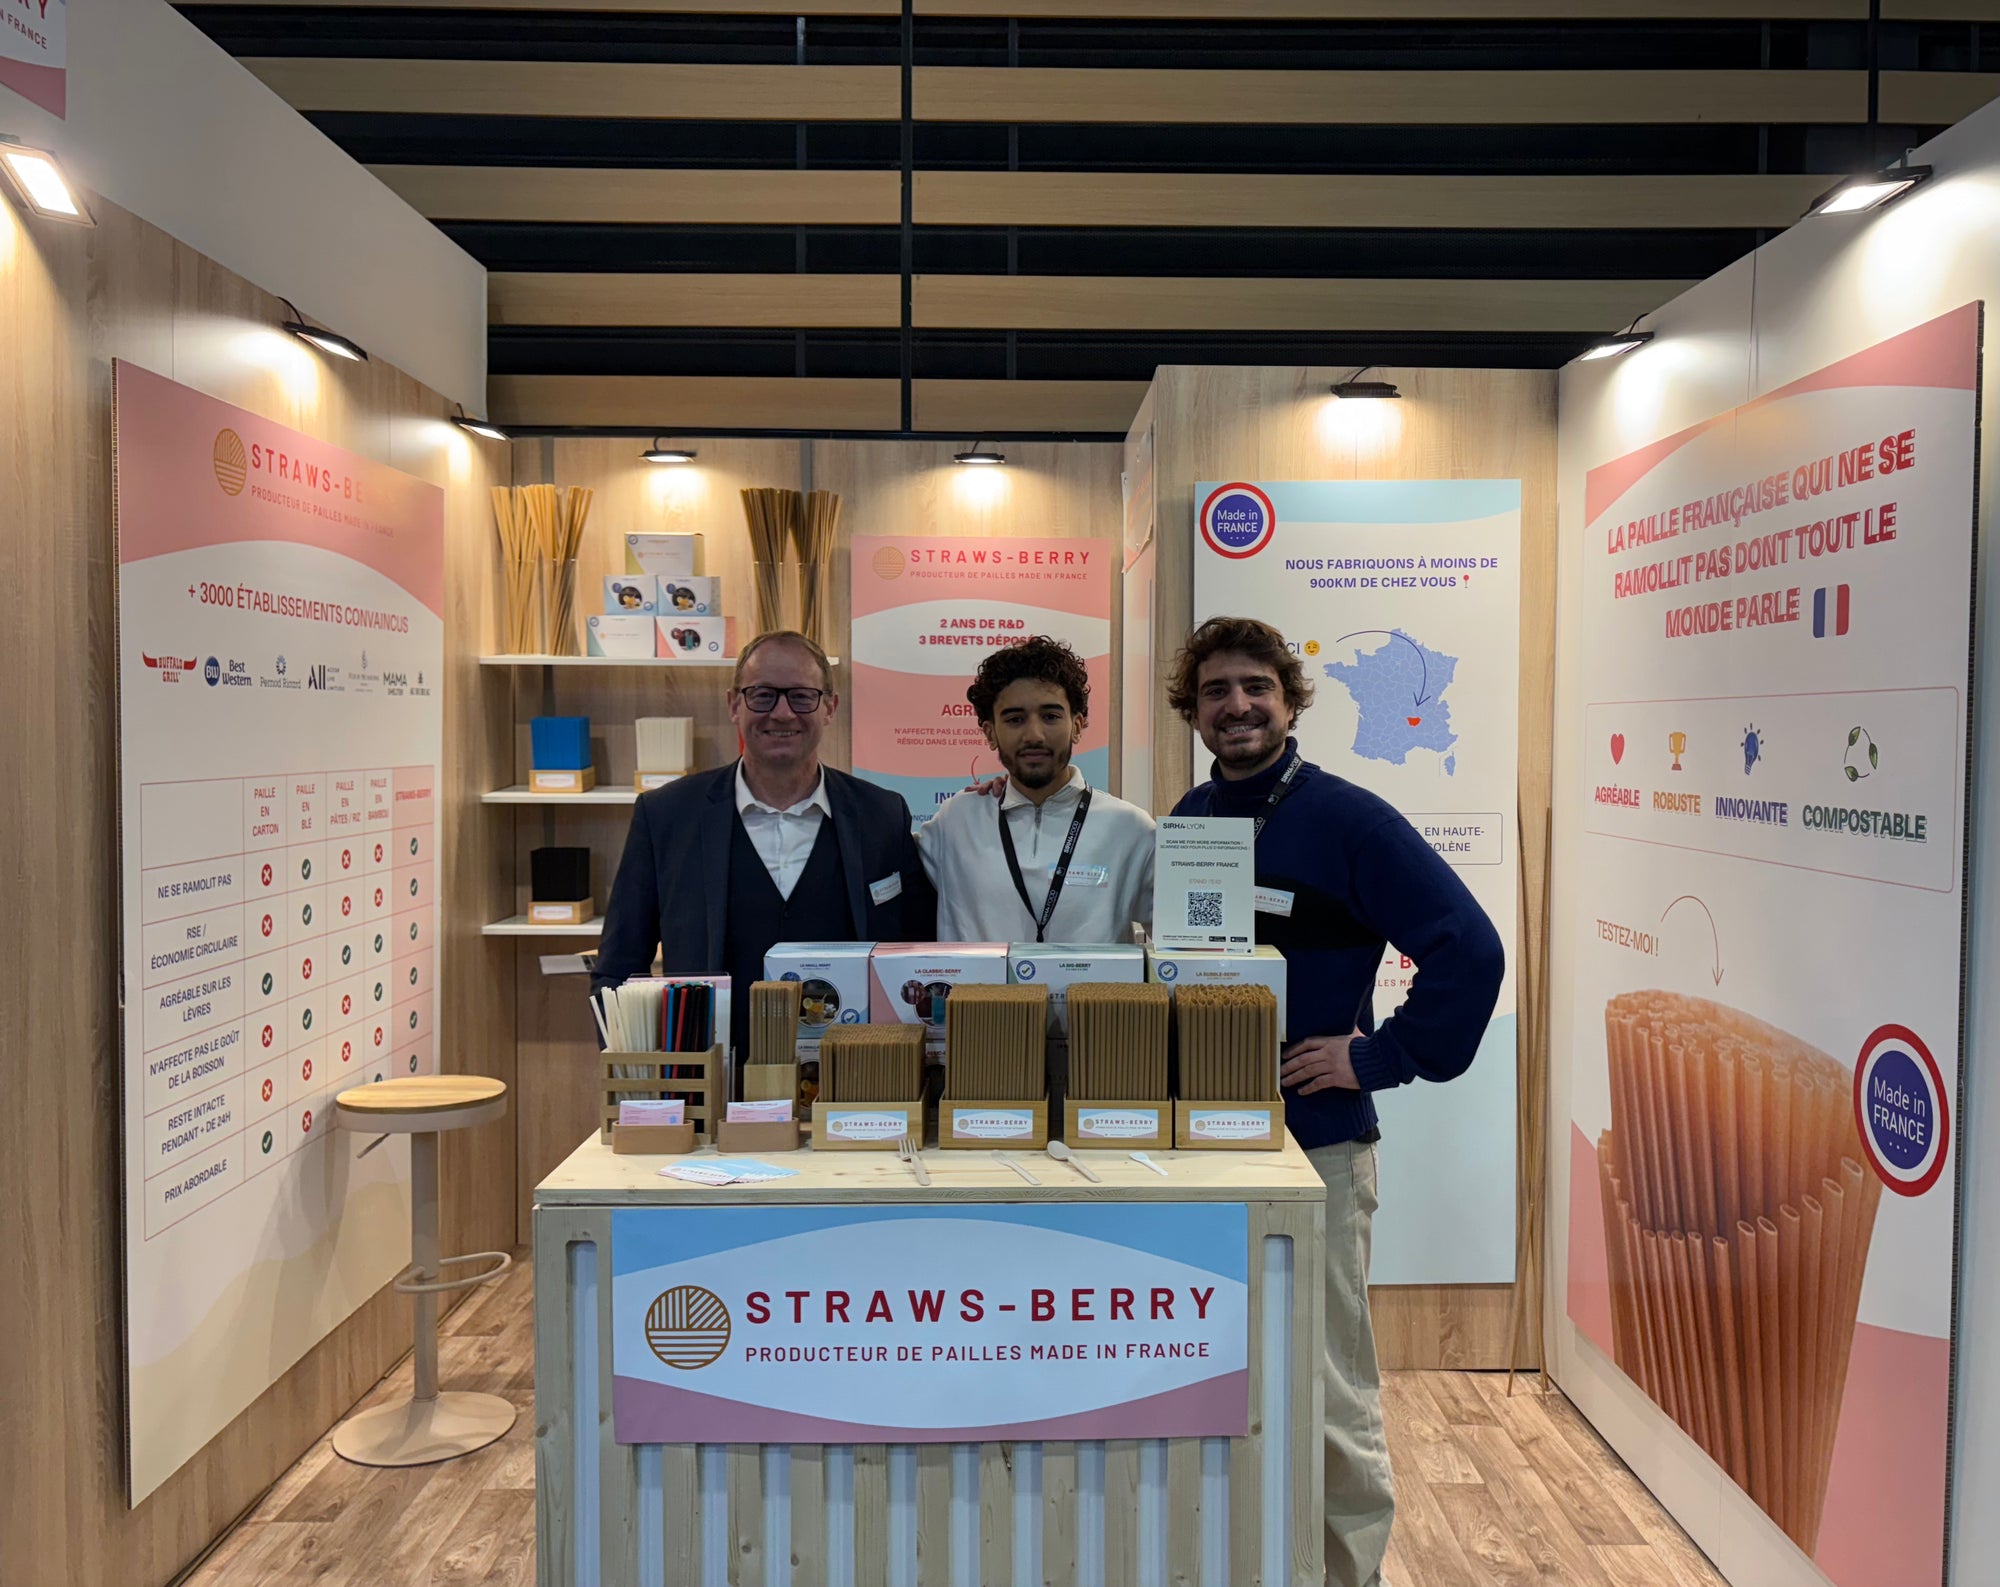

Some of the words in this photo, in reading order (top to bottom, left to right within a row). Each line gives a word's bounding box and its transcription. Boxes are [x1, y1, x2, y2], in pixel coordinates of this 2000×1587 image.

[8, 13, 47, 50] FRANCE
[1608, 528, 1625, 554] LA
[1628, 508, 1680, 550] PAILLE
[1682, 470, 1789, 535] FRANÇAISE
[1792, 456, 1834, 501] QUI
[1837, 442, 1875, 488] NE
[1878, 428, 1916, 475] SE
[251, 485, 300, 508] PRODUCTEUR
[313, 505, 342, 523] PAILLES
[1217, 508, 1246, 521] Made
[1248, 508, 1258, 521] in
[1217, 522, 1258, 533] FRANCE
[910, 549, 1091, 565] STRAWS-BERRY
[1615, 555, 1693, 599] RAMOLLIT
[1695, 546, 1732, 583] PAS
[1735, 530, 1794, 574] DONT
[1795, 511, 1861, 560] TOUT
[1863, 502, 1897, 545] LE
[1286, 559, 1323, 570] NOUS
[1327, 558, 1414, 571] FABRIQUONS
[1418, 556, 1427, 569] À
[1431, 558, 1477, 569] MOINS
[1481, 557, 1498, 568] DE
[910, 570, 965, 579] PRODUCTEUR
[967, 571, 979, 580] DE
[980, 571, 1016, 580] PAILLES
[1018, 571, 1041, 580] MADE
[1043, 571, 1052, 580] IN
[1054, 571, 1088, 580] FRANCE
[1310, 577, 1357, 588] 900KM
[1361, 577, 1378, 588] DE
[1381, 576, 1416, 588] CHEZ
[1420, 576, 1457, 588] VOUS
[200, 582, 233, 607] 3000
[237, 582, 342, 624] ÉTABLISSEMENTS
[345, 607, 409, 633] CONVAINCUS
[1665, 600, 1733, 638] MONDE
[1736, 586, 1801, 629] PARLE
[940, 618, 948, 629] 2
[950, 618, 977, 629] ANS
[979, 618, 996, 630] DE
[998, 618, 1025, 630] R&D
[919, 635, 927, 646] 3
[929, 635, 983, 646] BREVETS
[158, 656, 183, 669] BUFFALO
[229, 659, 245, 673] Best
[163, 671, 178, 683] GRILL
[222, 673, 252, 686] Western
[260, 676, 281, 688] Pernod
[383, 672, 407, 686] MAMA
[894, 727, 934, 736] N'AFFECTE
[936, 728, 950, 736] PAS
[951, 728, 960, 736] LE
[961, 726, 985, 737] GOÛT
[897, 737, 924, 746] RÉSIDU
[926, 738, 946, 746] DANS
[948, 738, 958, 746] LE
[959, 738, 983, 746] VERRE
[296, 784, 316, 795] PAILLE
[335, 780, 354, 791] PAILLE
[370, 778, 387, 788] PAILLE
[254, 787, 276, 799] PAILLE
[1594, 784, 1641, 808] AGRÉABLE
[301, 801, 310, 812] EN
[341, 797, 349, 807] EN
[1653, 791, 1701, 815] ROBUSTE
[261, 806, 270, 817] EN
[1715, 796, 1788, 826] INNOVANTE
[301, 817, 312, 830] BLÉ
[330, 812, 347, 825] PÂTES
[1802, 804, 1927, 842] COMPOSTABLE
[252, 823, 279, 837] CARTON
[1425, 827, 1440, 836] EN
[1443, 827, 1484, 836] HAUTE-
[157, 885, 170, 899] NE
[170, 883, 181, 897] SE
[181, 876, 217, 896] RAMOLIT
[217, 873, 232, 888] PAS
[186, 926, 201, 940] RSE
[1596, 919, 1654, 955] TESTEZ-MOI
[151, 946, 196, 970] ÉCONOMIE
[196, 935, 238, 959] CIRCULAIRE
[159, 983, 201, 1010] AGRÉABLE
[201, 979, 218, 998] SUR
[218, 975, 231, 992] LES
[182, 1002, 211, 1023] LÈVRES
[150, 1049, 193, 1077] N'AFFECTE
[194, 1043, 210, 1061] PAS
[211, 1040, 219, 1055] LE
[220, 1029, 240, 1051] GOÛT
[168, 1075, 179, 1090] DE
[180, 1070, 191, 1086] LA
[191, 1056, 225, 1081] BOISSON
[1874, 1076, 1910, 1112] Made
[1912, 1090, 1926, 1117] in
[168, 1109, 192, 1131] RESTE
[193, 1094, 226, 1120] INTACTE
[844, 1121, 903, 1129] STRAWS-BERRY
[1873, 1108, 1925, 1146] FRANCE
[161, 1129, 199, 1155] PENDANT
[205, 1117, 217, 1134] DE
[217, 1112, 231, 1129] 24H
[164, 1182, 182, 1203] PRIX
[182, 1159, 227, 1193] ABORDABLE
[746, 1286, 1216, 1325] STRAWS-BERRY
[746, 1345, 889, 1363] PRODUCTEUR
[898, 1344, 926, 1362] DE
[931, 1344, 1022, 1362] PAILLES
[1031, 1344, 1088, 1360] MADE
[1096, 1343, 1117, 1359] IN
[1126, 1342, 1211, 1359] FRANCE
